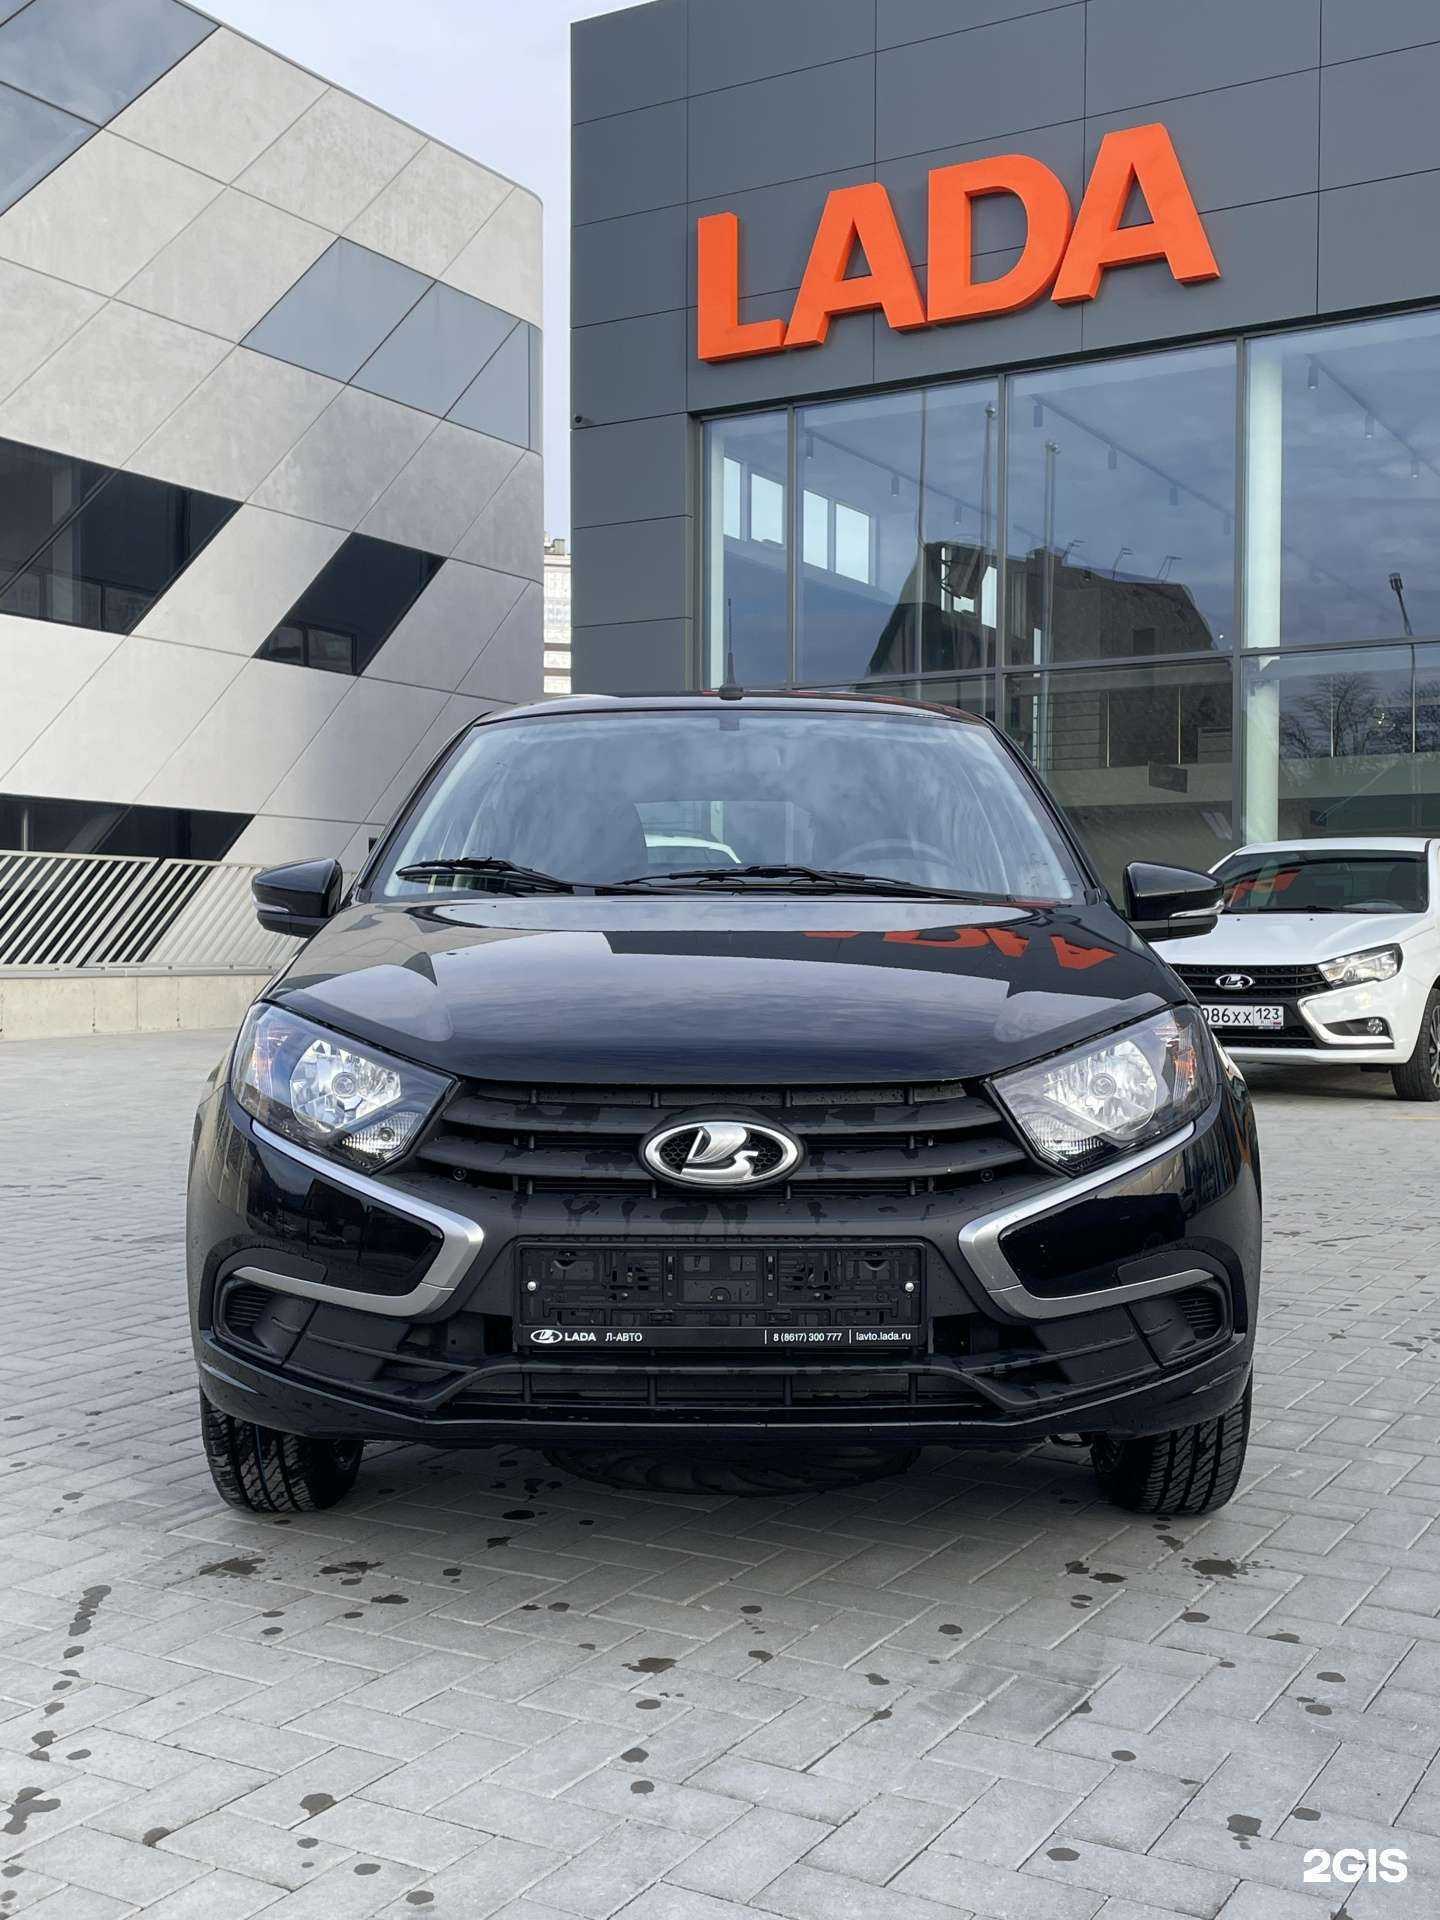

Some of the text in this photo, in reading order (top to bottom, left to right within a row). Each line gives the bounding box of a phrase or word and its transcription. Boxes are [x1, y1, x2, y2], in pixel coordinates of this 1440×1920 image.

[697, 122, 1221, 362] LADA
[1256, 1007, 1280, 1020] 123
[564, 1331, 597, 1342] LADA
[605, 1331, 643, 1342] Л-АВТО
[780, 1332, 807, 1343] (8617)
[808, 1332, 825, 1342] 300
[826, 1332, 843, 1342] 777
[856, 1331, 911, 1341] lavto.lada.ru
